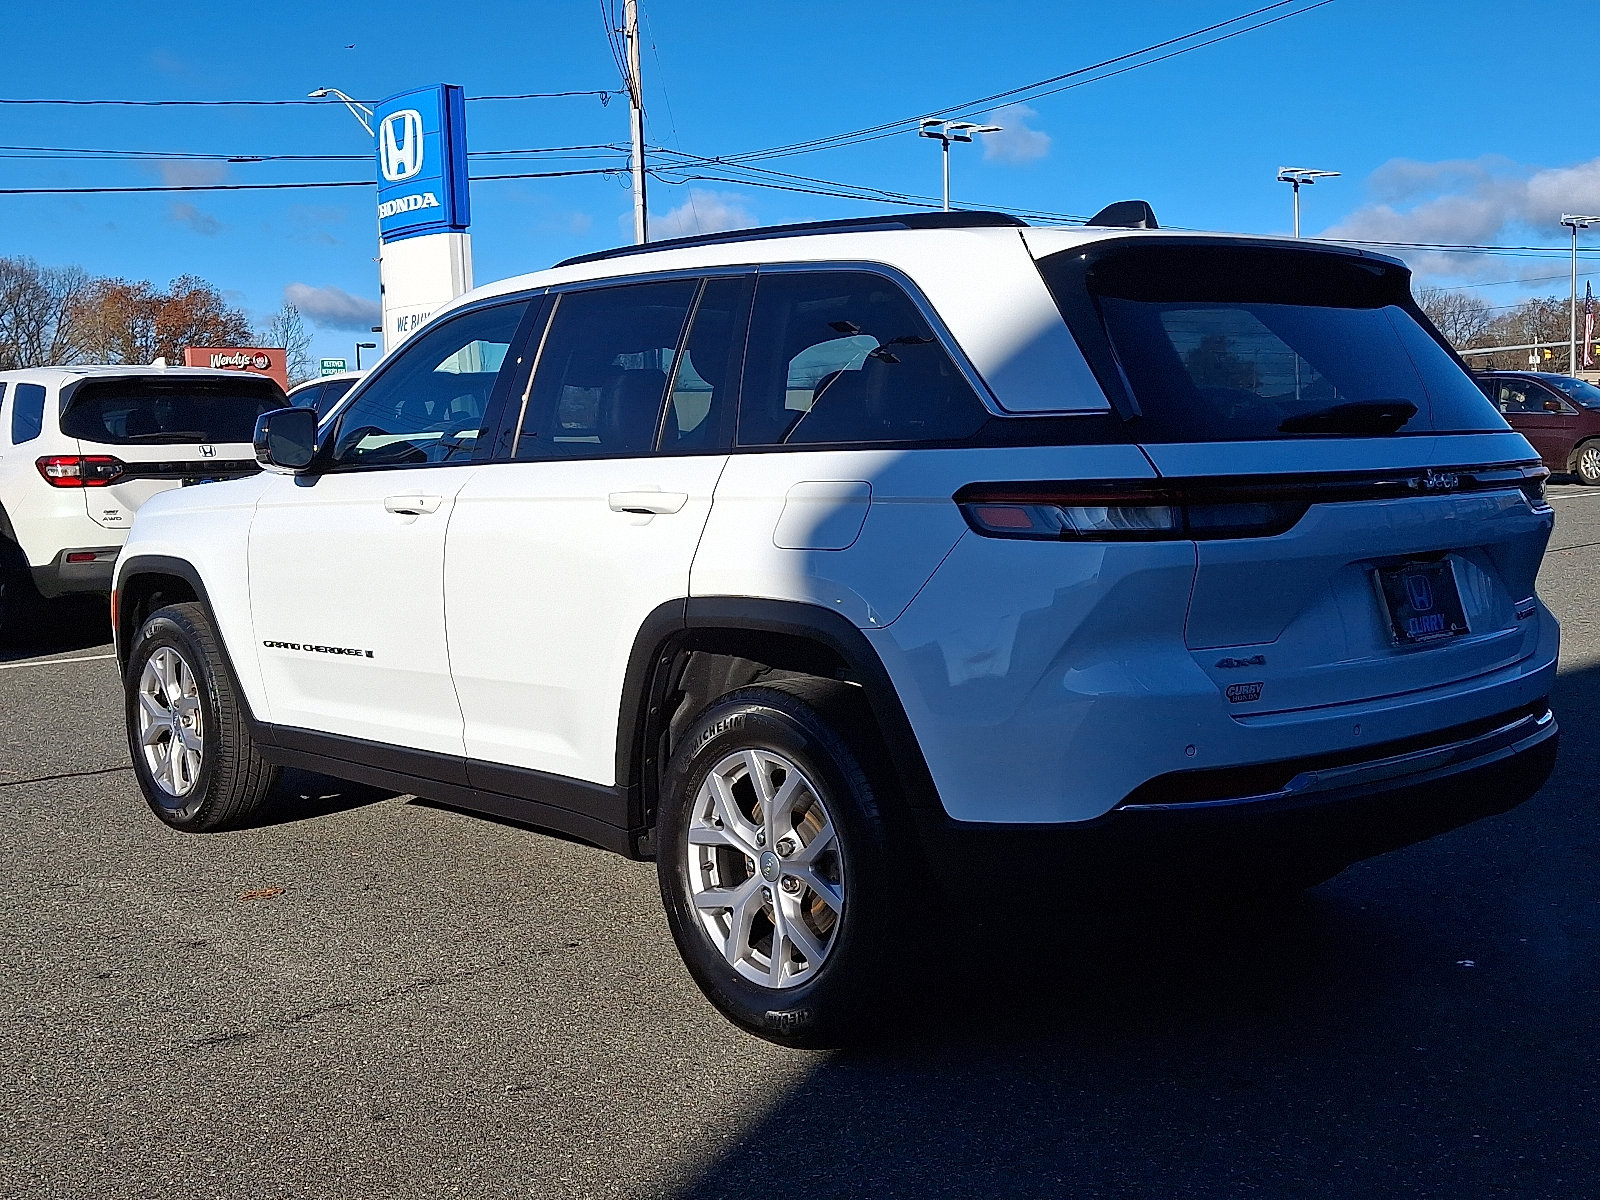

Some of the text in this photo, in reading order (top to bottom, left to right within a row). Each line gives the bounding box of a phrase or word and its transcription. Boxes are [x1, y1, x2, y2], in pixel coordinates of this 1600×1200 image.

[378, 192, 440, 219] HONDA
[397, 316, 408, 332] WE
[210, 352, 250, 368] Wendy's
[1423, 469, 1459, 489] Jeep
[1408, 614, 1445, 635] CURRY
[263, 640, 363, 657] GRAND CHEROKEE
[1228, 683, 1263, 697] CURRY
[1232, 693, 1259, 702] HONDA
[691, 713, 748, 755] MICHELIN
